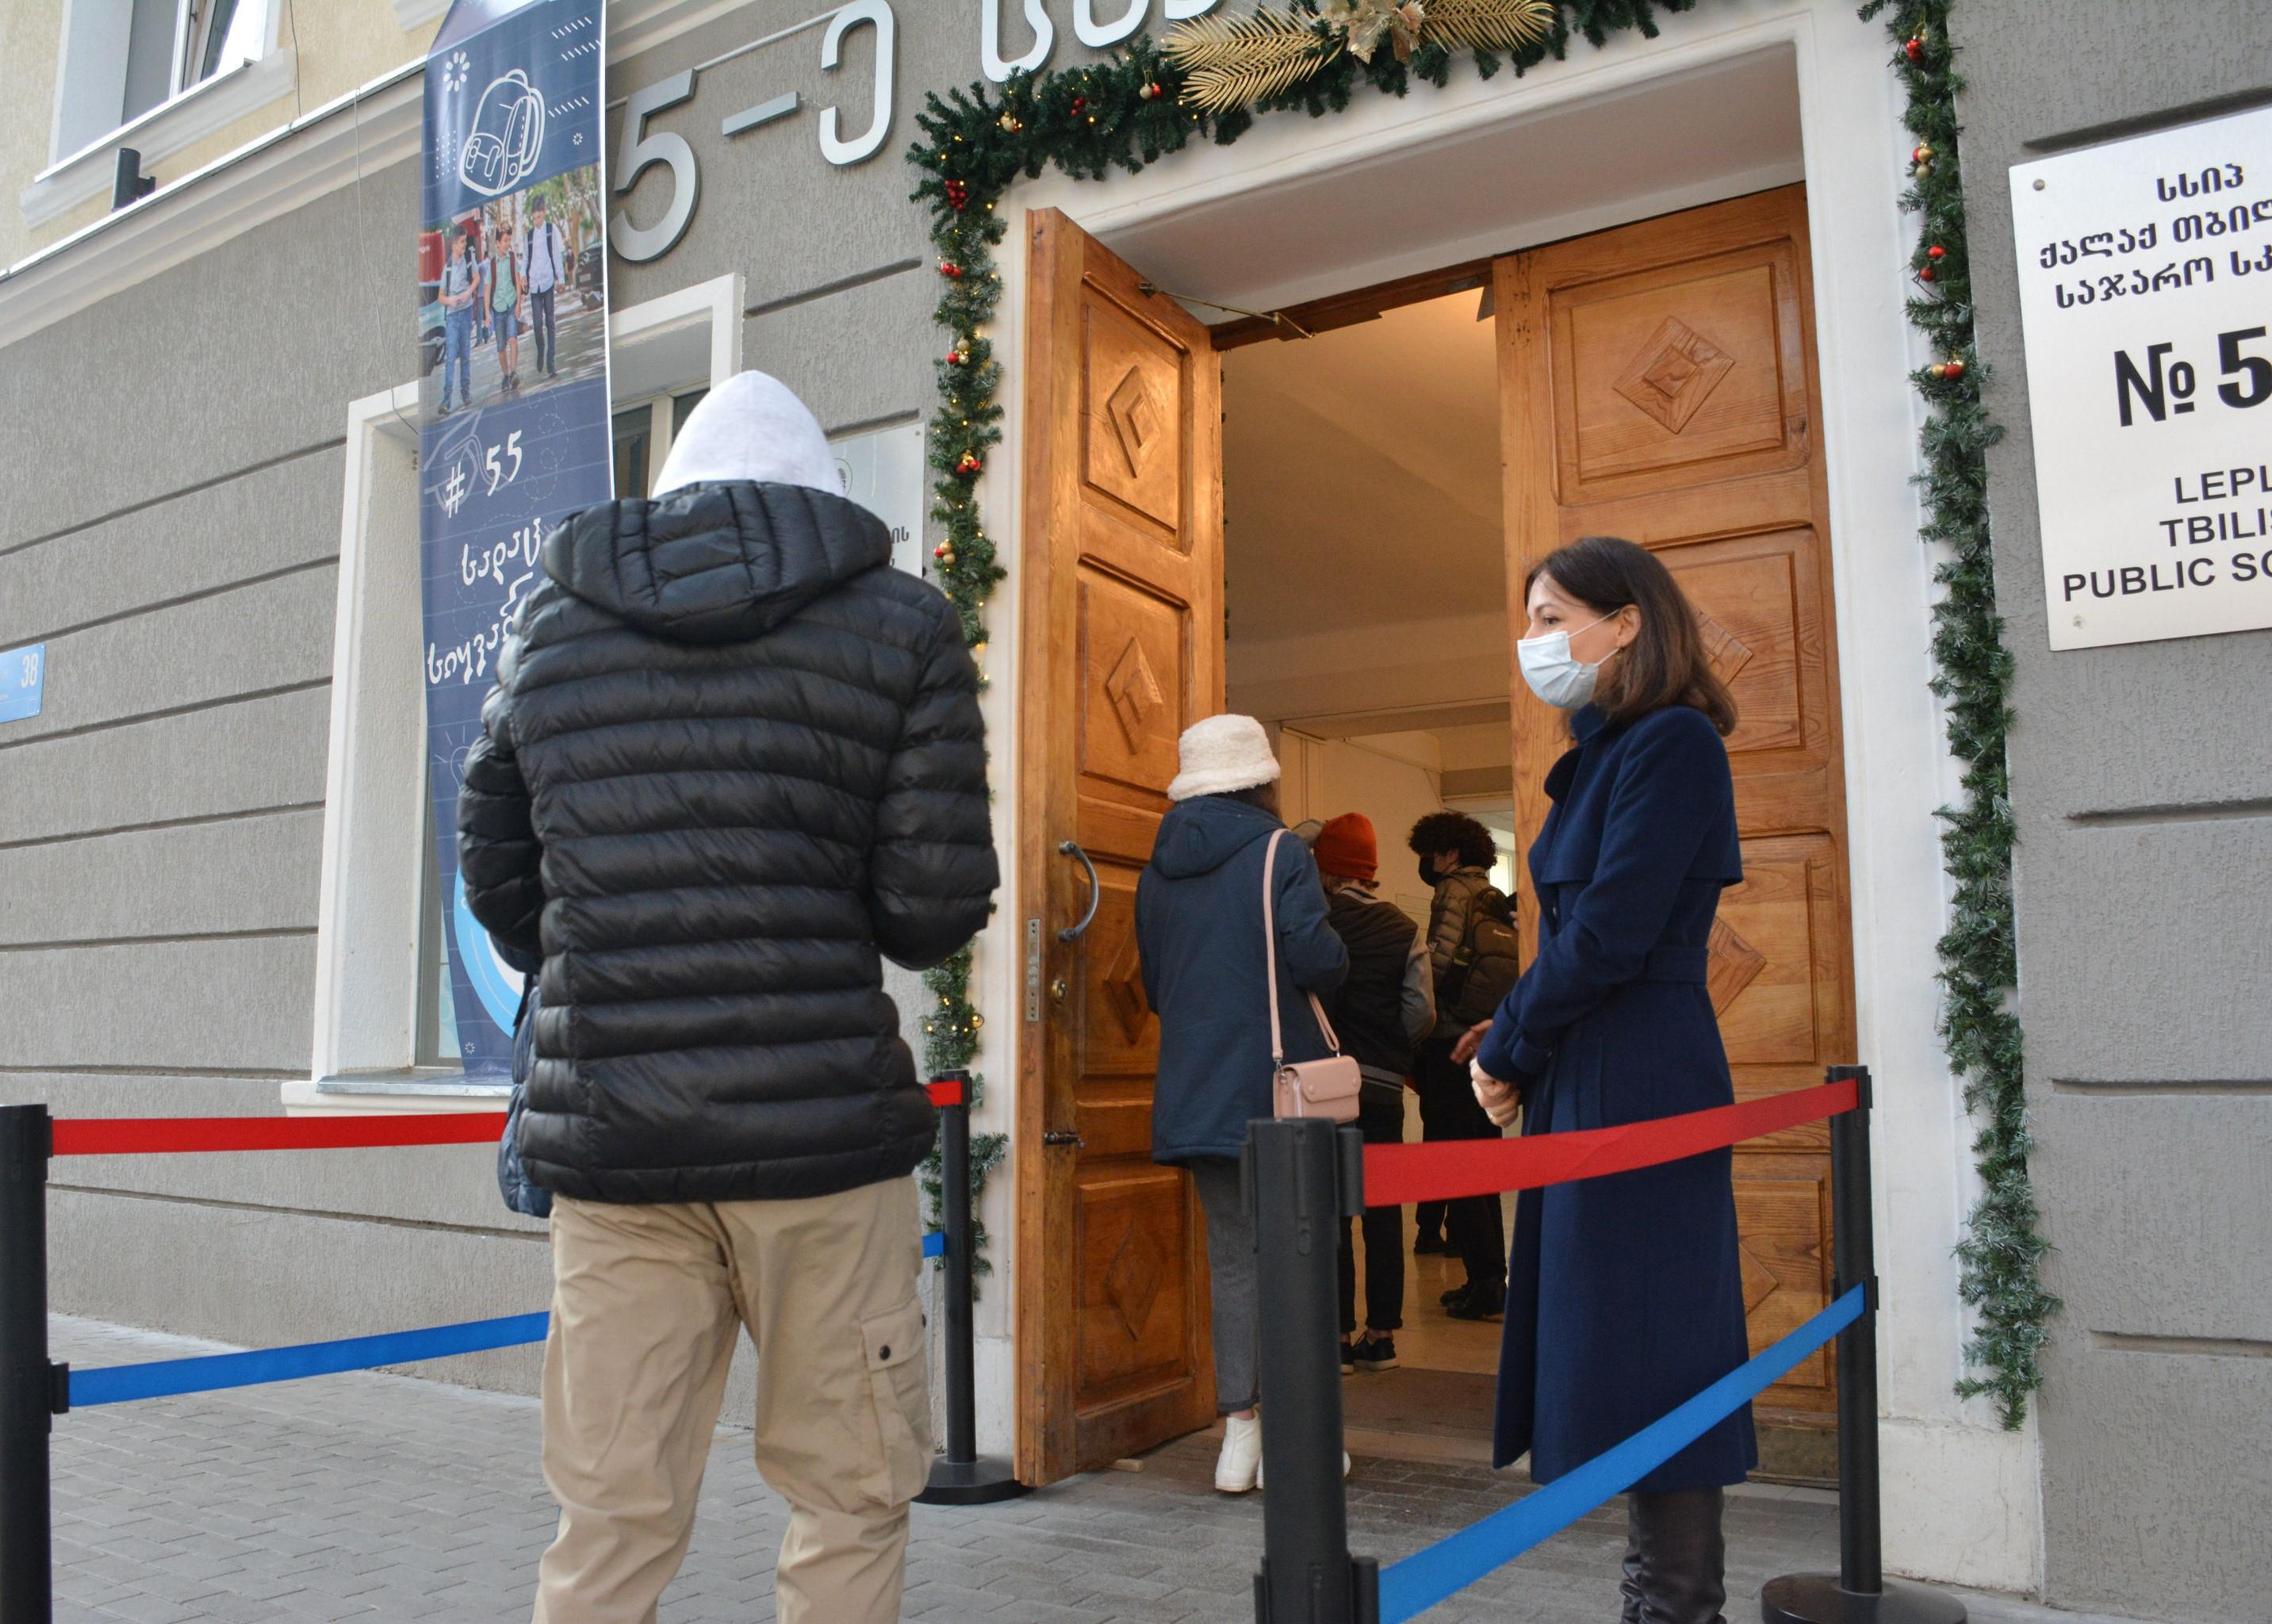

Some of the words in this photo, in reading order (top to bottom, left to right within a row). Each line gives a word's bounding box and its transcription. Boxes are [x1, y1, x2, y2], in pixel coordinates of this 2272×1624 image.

[2155, 163, 2244, 202] სსიპ
[2039, 223, 2157, 269] ქალაქ
[2055, 255, 2215, 308] საჯარო
[2216, 326, 2272, 408] 5
[2159, 508, 2272, 547] TBILI
[2063, 557, 2216, 603] PUBLIC
[21, 653, 39, 688] 38
